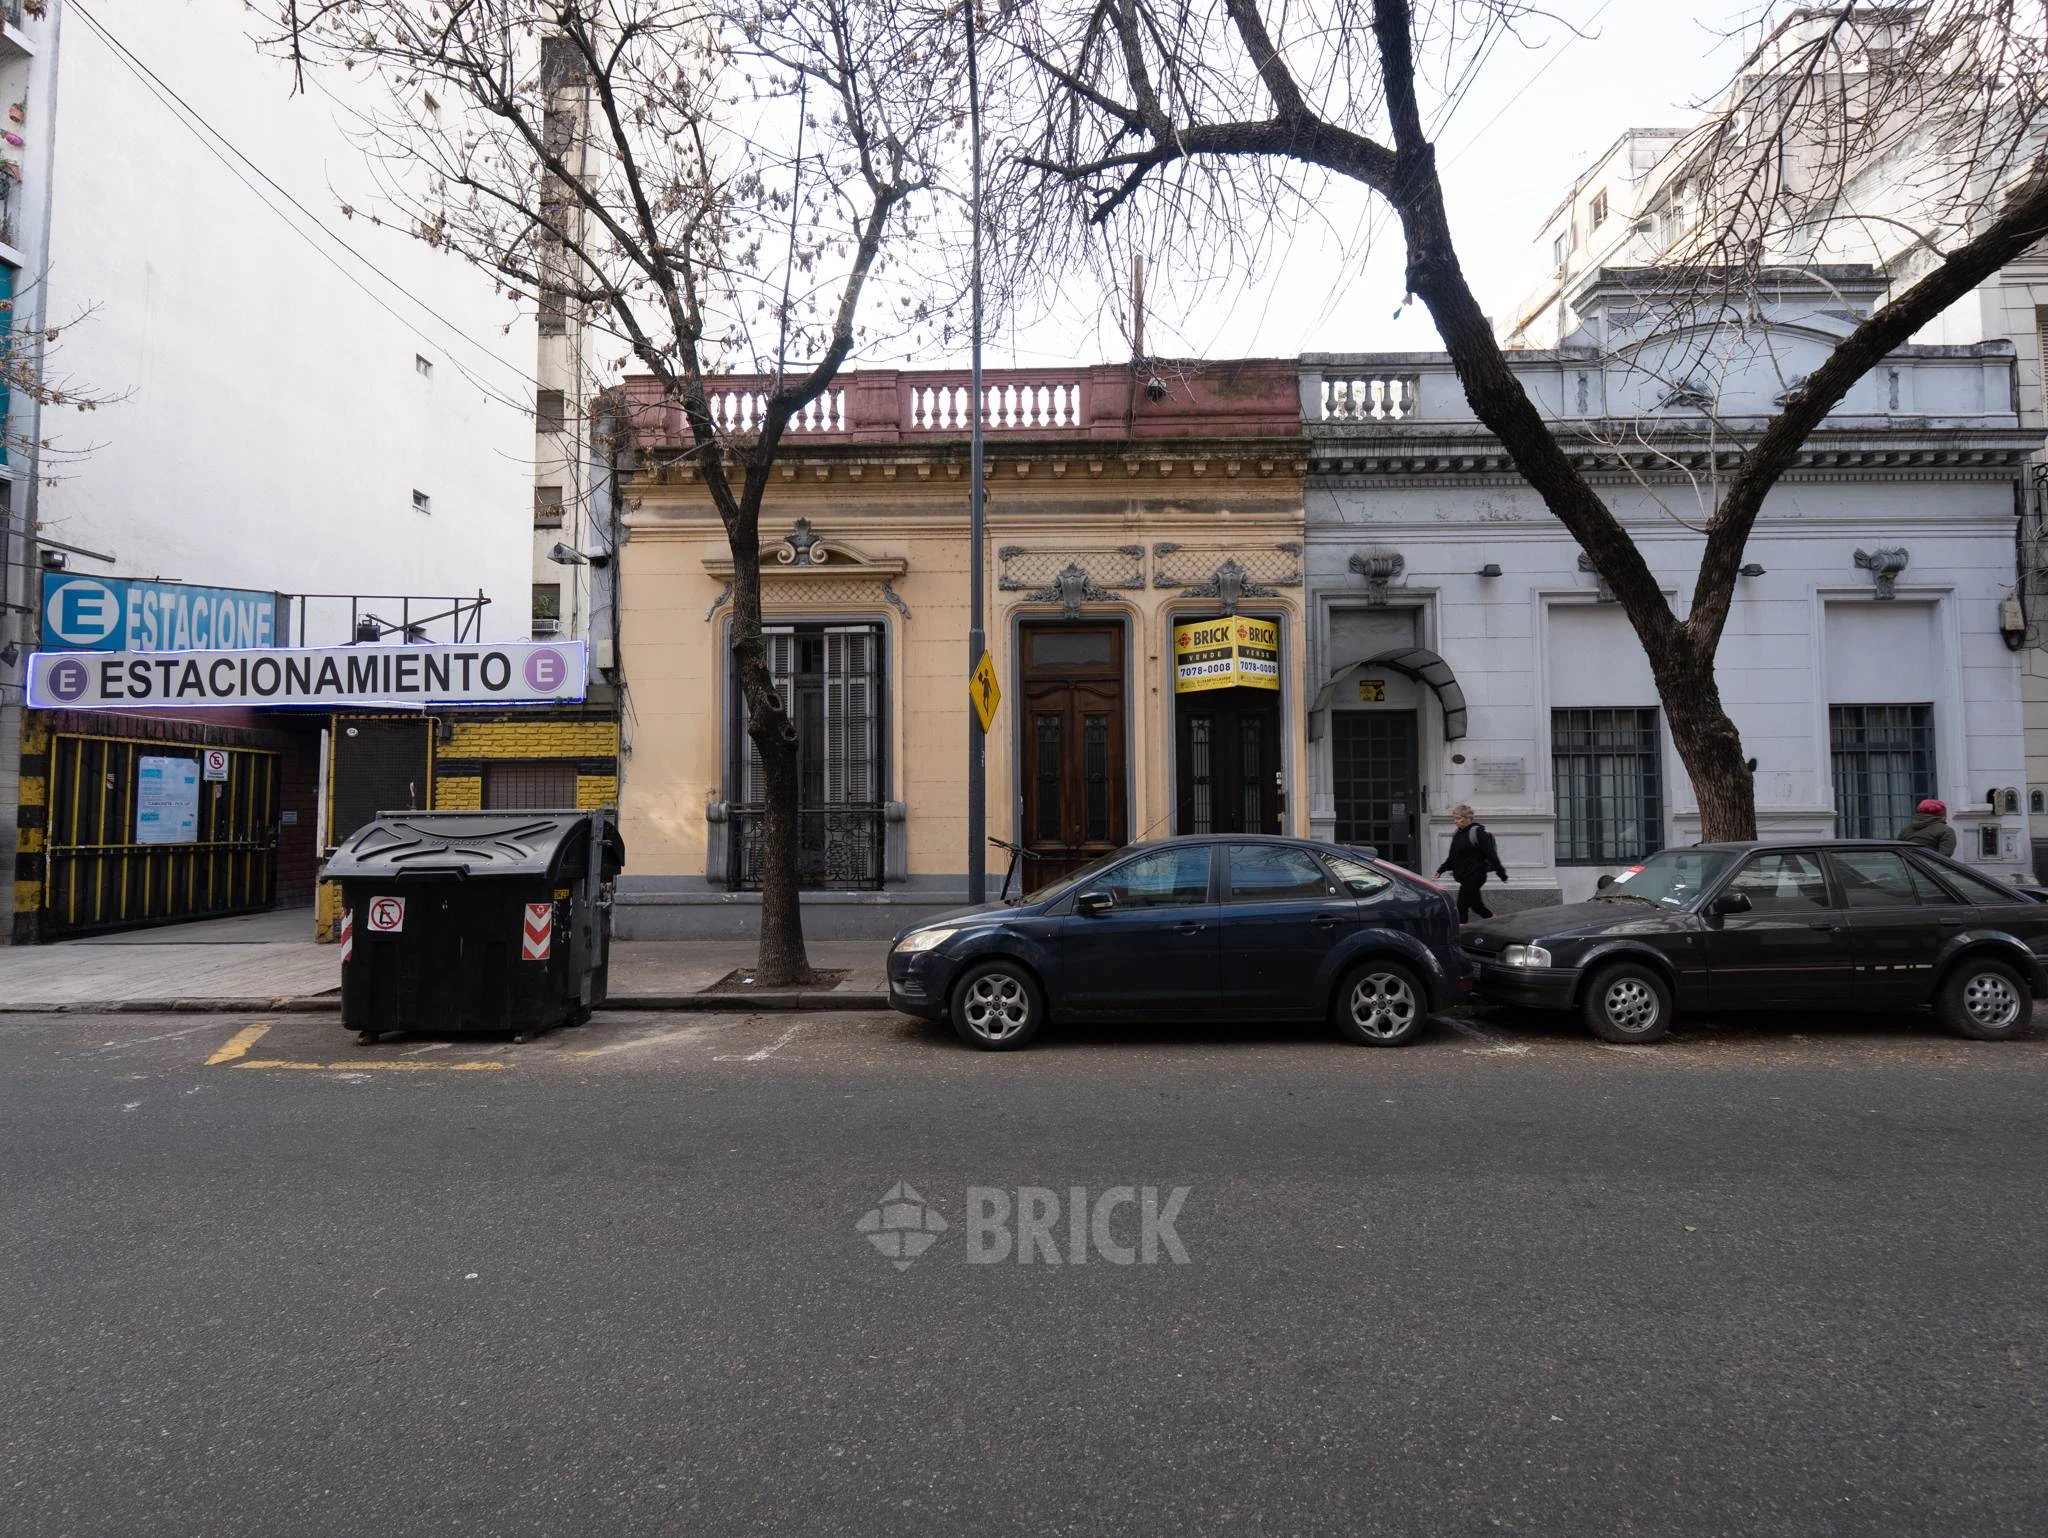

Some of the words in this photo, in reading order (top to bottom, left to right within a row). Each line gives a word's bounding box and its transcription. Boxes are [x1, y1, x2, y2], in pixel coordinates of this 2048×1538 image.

[61, 589, 105, 635] E
[126, 588, 272, 651] ESTACIONE
[1194, 626, 1229, 645] BRICK
[1249, 627, 1274, 645] BRICK
[1189, 651, 1223, 662] VENDE
[1246, 649, 1270, 659] VENDE
[100, 651, 512, 700] ESTACIONAMIENTO
[1180, 662, 1231, 677] 7078-0008
[1240, 661, 1277, 674] 7078-0008
